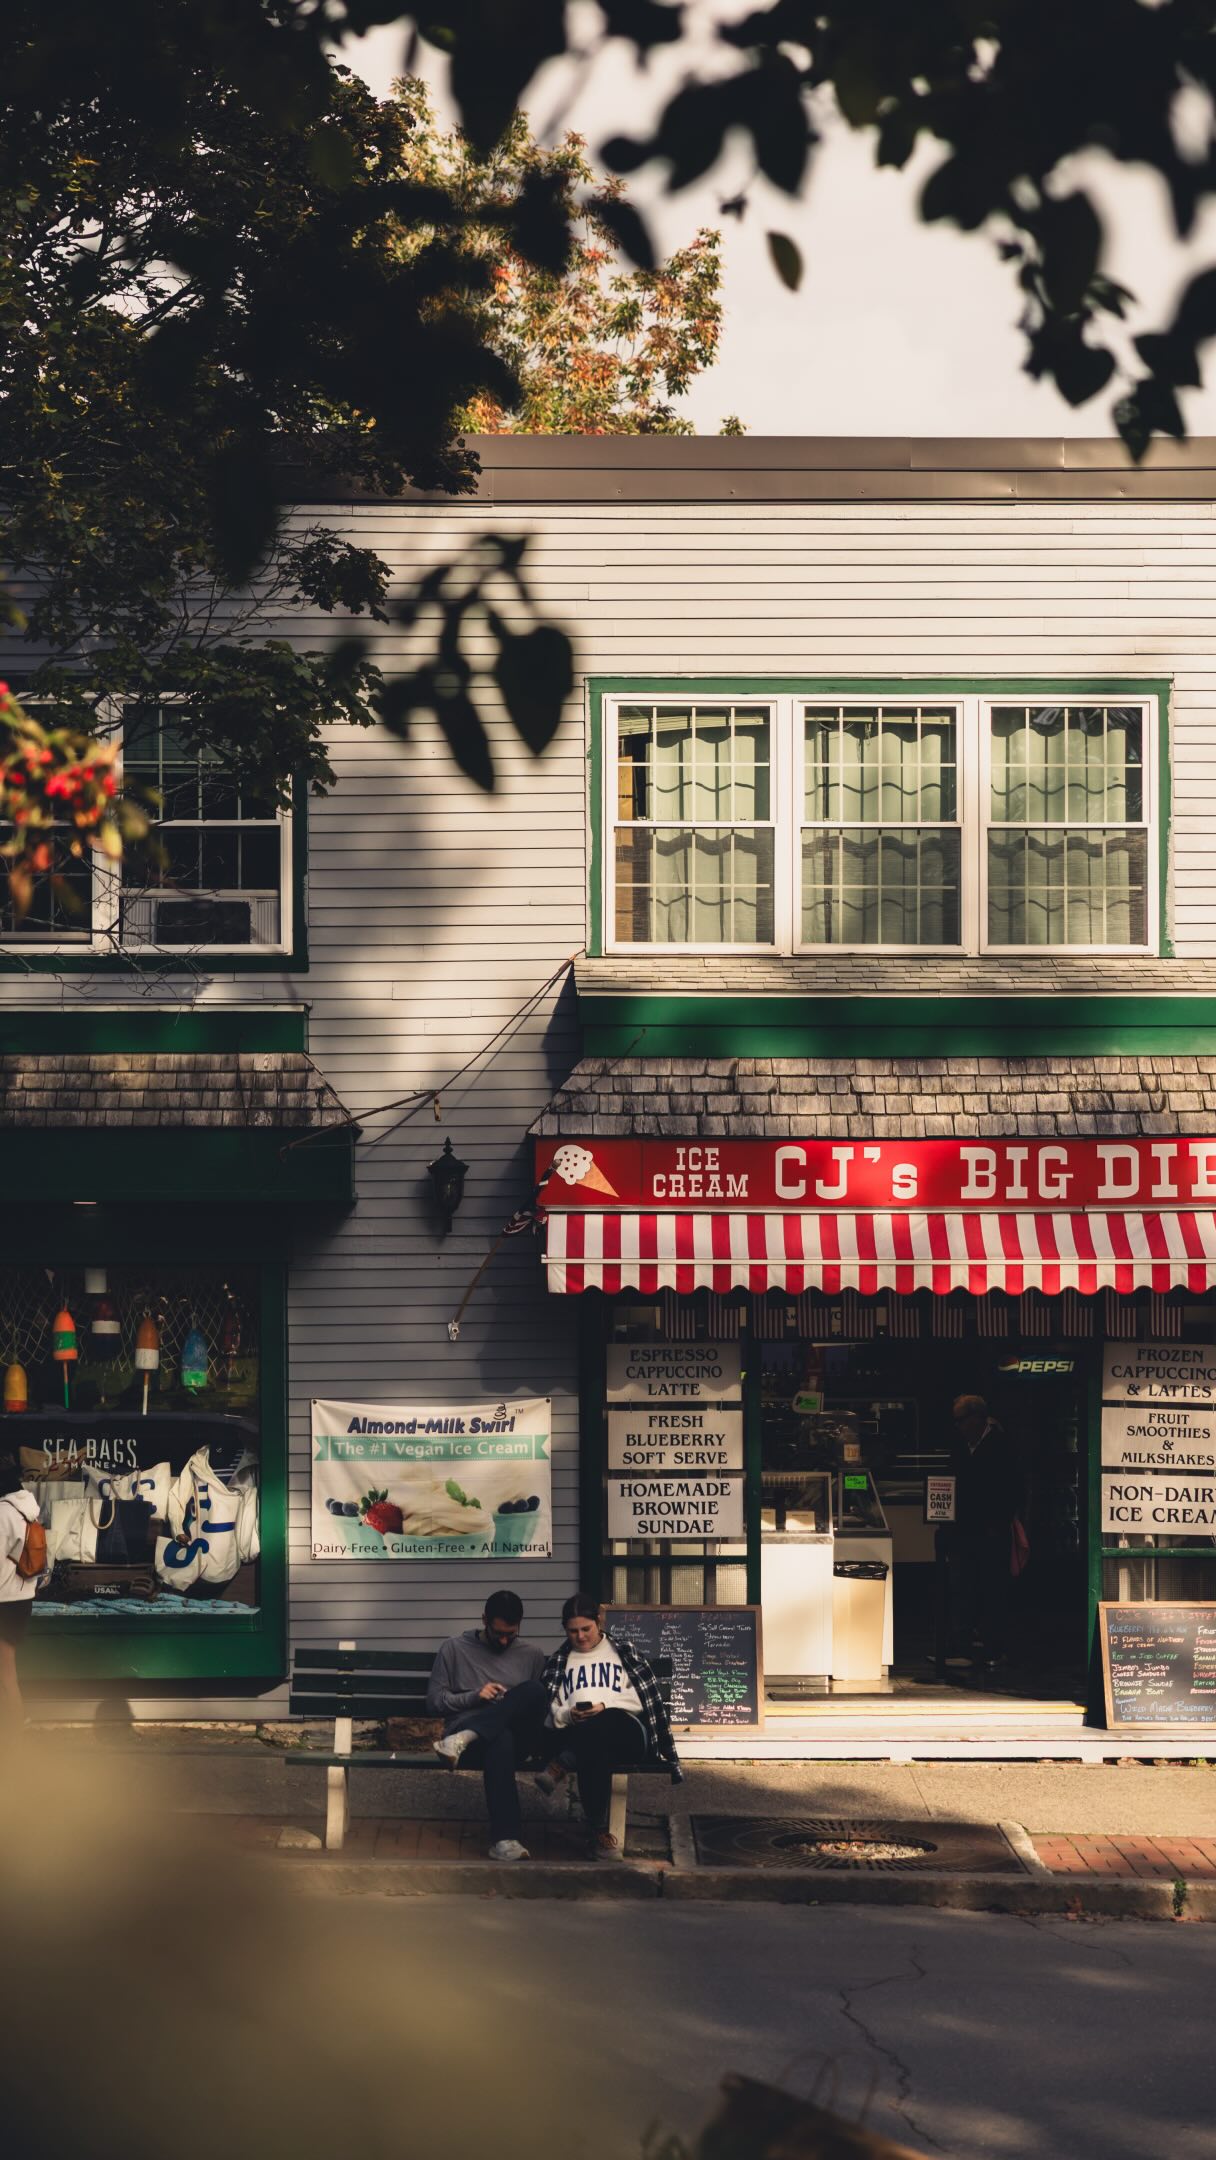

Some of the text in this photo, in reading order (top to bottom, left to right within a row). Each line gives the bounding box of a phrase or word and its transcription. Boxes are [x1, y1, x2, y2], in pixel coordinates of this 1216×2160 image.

[676, 1147, 720, 1171] ICE
[775, 1146, 918, 1200] CJ's
[960, 1146, 1074, 1200] BIG
[653, 1173, 749, 1198] CREAM
[629, 1348, 719, 1363] ESPRESSO
[1137, 1348, 1205, 1364] FROZEN
[626, 1365, 723, 1379] CAPPUCCINO
[1017, 1360, 1076, 1373] PEPSI
[647, 1383, 701, 1396] LATTE
[1126, 1383, 1212, 1399] & LATTES
[346, 1416, 466, 1435] Almond-Milk
[469, 1414, 516, 1434] Swirl
[648, 1415, 704, 1428] FRESH
[1148, 1413, 1190, 1425] FRUIT
[626, 1433, 726, 1447] BLUEBERRY
[1126, 1426, 1211, 1439] SMOOTHIES
[336, 1441, 529, 1459] The #1 Vegan Ice Cream
[1162, 1439, 1174, 1451] &
[42, 1438, 137, 1469] SEA BAGS
[622, 1451, 728, 1465] SOFT SERVE
[1121, 1452, 1215, 1466] MILKSHAKES
[70, 1460, 110, 1469] MAINE
[619, 1482, 732, 1498] HOMEMADE
[930, 1493, 952, 1501] CASH
[1109, 1485, 1216, 1504] NON-DAIR
[632, 1501, 720, 1516] BROWNIE
[930, 1501, 952, 1510] ONLY
[1109, 1506, 1144, 1522] ICE
[637, 1519, 715, 1535] SUNDAE
[313, 1541, 549, 1556] Dairy-Free Gluten-Free All Natural
[562, 1662, 623, 1701] MAINE
